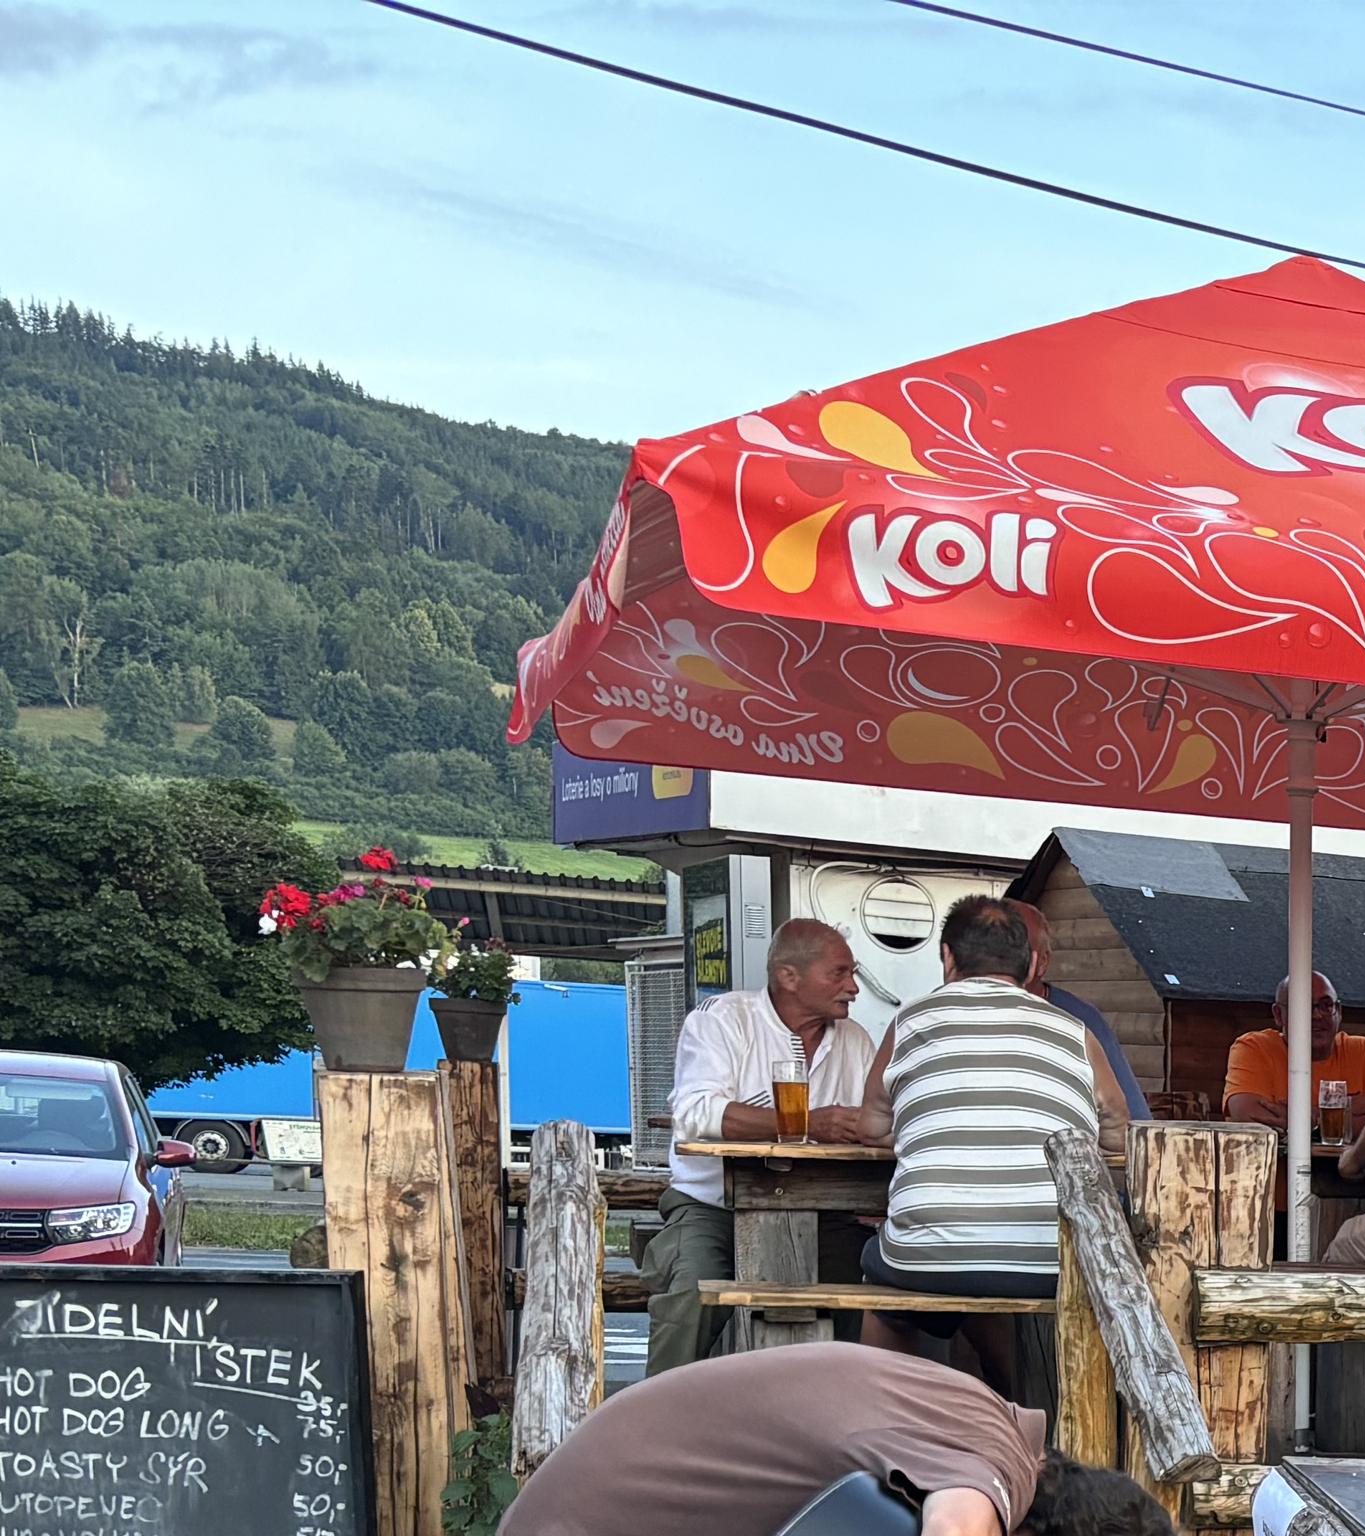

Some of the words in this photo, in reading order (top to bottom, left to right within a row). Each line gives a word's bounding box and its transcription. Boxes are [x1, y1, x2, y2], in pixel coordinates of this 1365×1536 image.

[561, 775, 584, 802] Loterie
[590, 771, 606, 804] losy
[606, 776, 613, 795] o
[69, 1365, 153, 1403] DOG
[62, 1406, 125, 1436] DOG
[139, 1408, 230, 1442] LONG
[0, 1449, 128, 1483] TOASTY
[139, 1450, 209, 1494] SÝR
